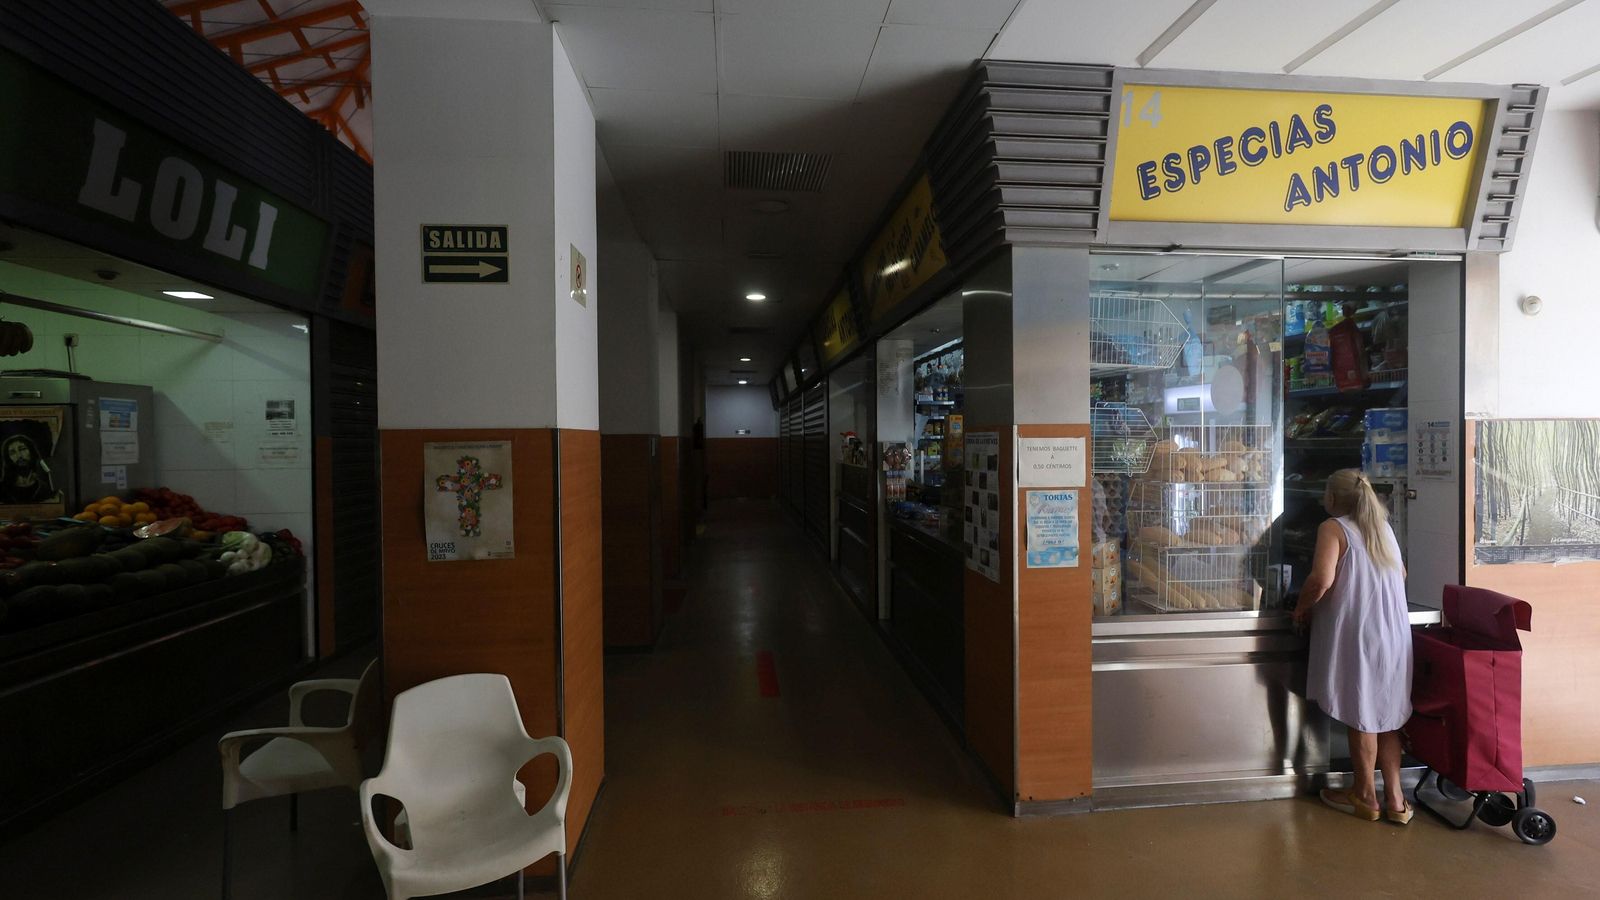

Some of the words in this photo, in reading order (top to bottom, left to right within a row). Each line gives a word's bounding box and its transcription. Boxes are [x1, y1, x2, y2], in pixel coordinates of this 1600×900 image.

[1122, 90, 1163, 128] 14
[1136, 104, 1337, 200] ESPECIAS
[78, 117, 278, 270] LOLI
[1284, 121, 1474, 213] ANTONIO
[429, 230, 502, 249] SALIDA
